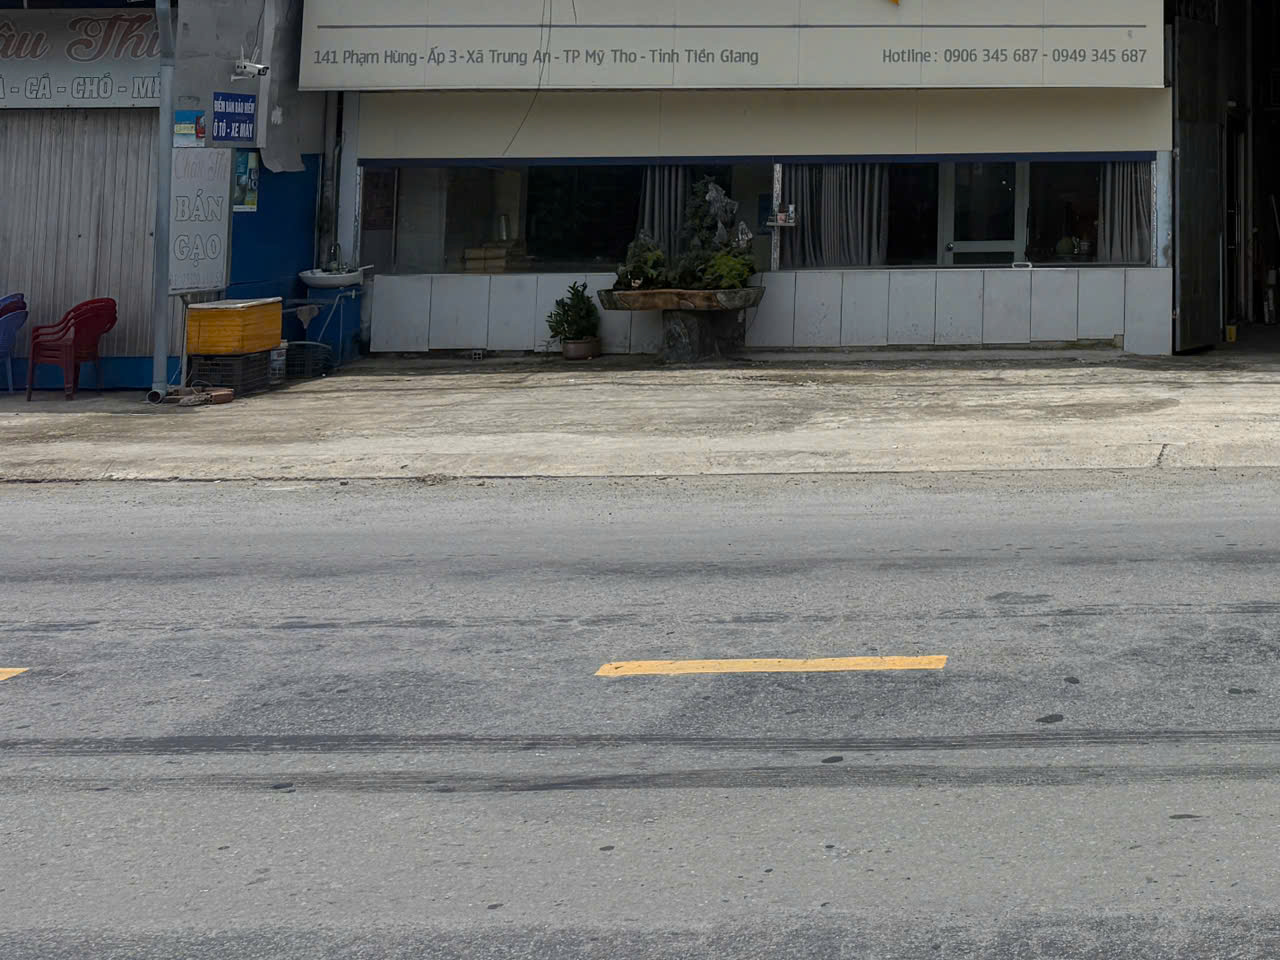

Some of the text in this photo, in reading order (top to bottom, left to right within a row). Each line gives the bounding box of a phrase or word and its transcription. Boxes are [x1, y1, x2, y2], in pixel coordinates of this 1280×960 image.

[313, 50, 338, 64] 141
[343, 50, 379, 67] Phạm
[384, 50, 417, 66] Hùng
[427, 46, 445, 66] Ấp
[449, 50, 456, 63] 3
[466, 50, 483, 64] Xã
[489, 49, 528, 66] Trung
[533, 50, 551, 64] An
[563, 49, 580, 63] TP
[585, 49, 605, 66] Mỹ
[611, 49, 637, 63] Tho
[720, 49, 759, 66] Giang
[944, 49, 977, 62] 0906
[982, 49, 1008, 62] 345
[1013, 49, 1038, 62] 687
[1052, 49, 1087, 62] 0949
[1091, 49, 1116, 62] 345
[1121, 49, 1147, 62] 687
[25, 72, 51, 99] CÁ
[71, 72, 113, 99] CHÓ
[175, 189, 223, 221] BÁN
[173, 234, 222, 267] GẠO
